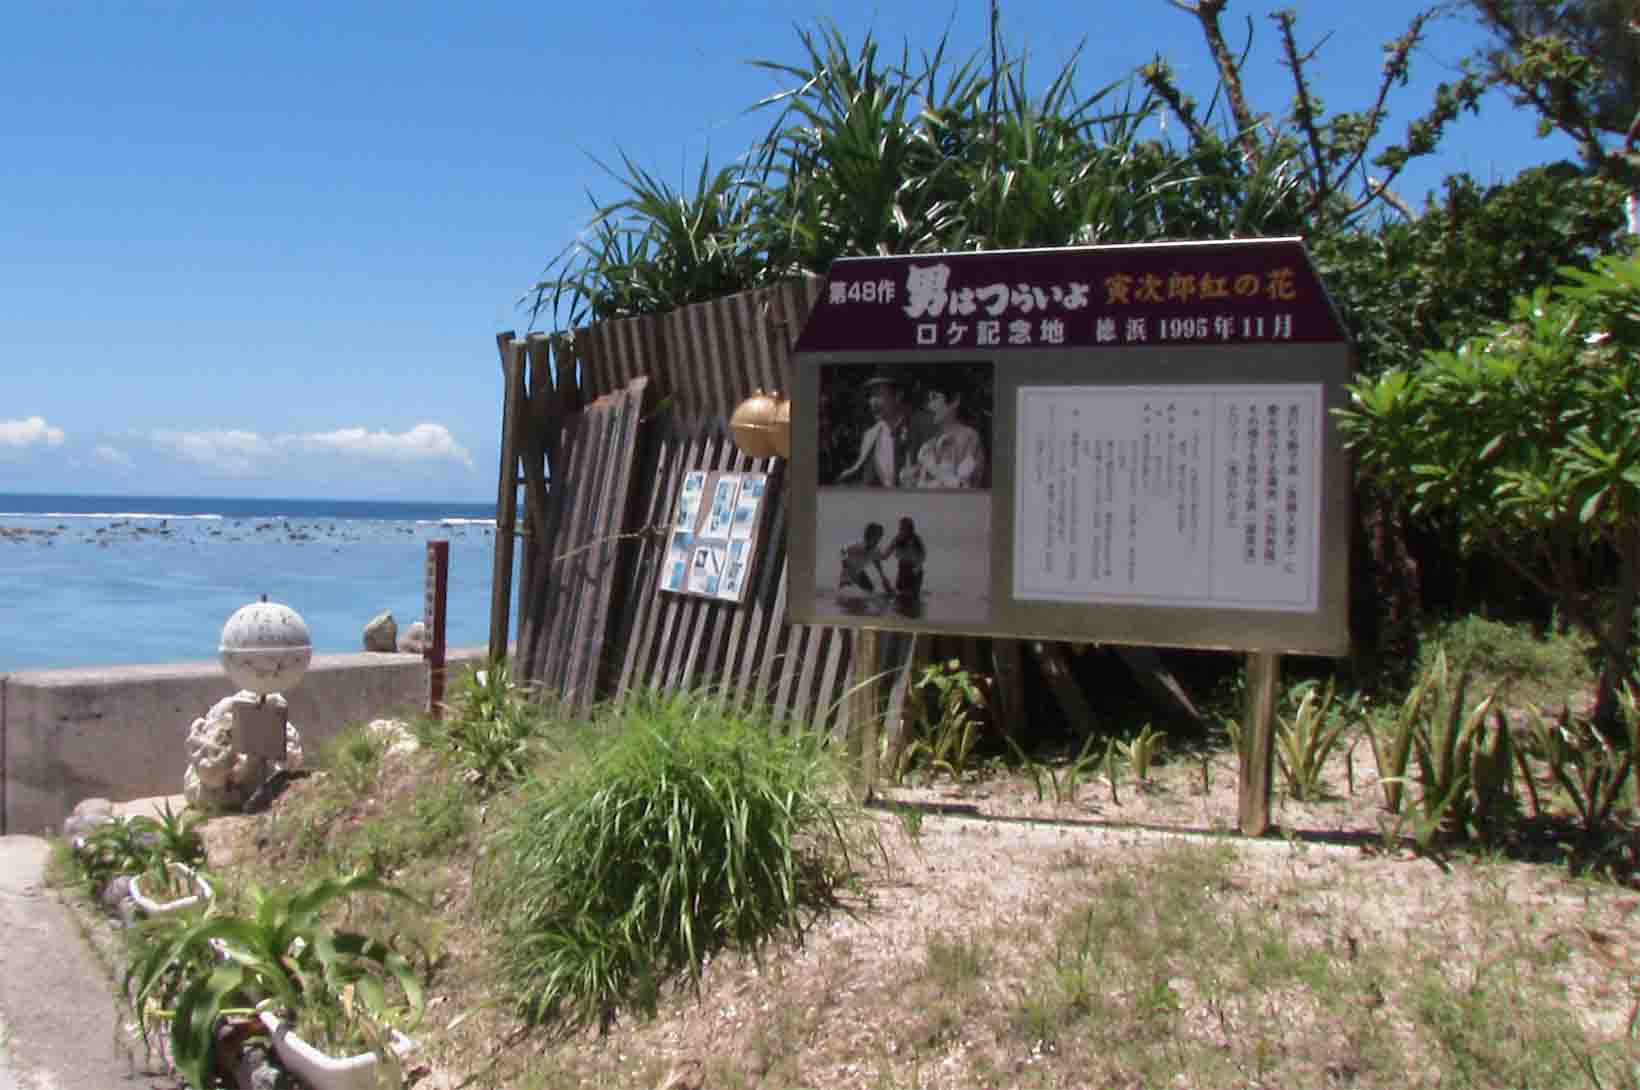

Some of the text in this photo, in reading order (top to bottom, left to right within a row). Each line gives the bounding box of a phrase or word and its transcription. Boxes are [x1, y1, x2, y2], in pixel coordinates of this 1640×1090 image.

[829, 262, 1297, 317] 第48作 男はつらいよ 寅次郎紅の花
[917, 319, 1065, 344] ロケ記念地
[1159, 315, 1292, 341] 1995年11月
